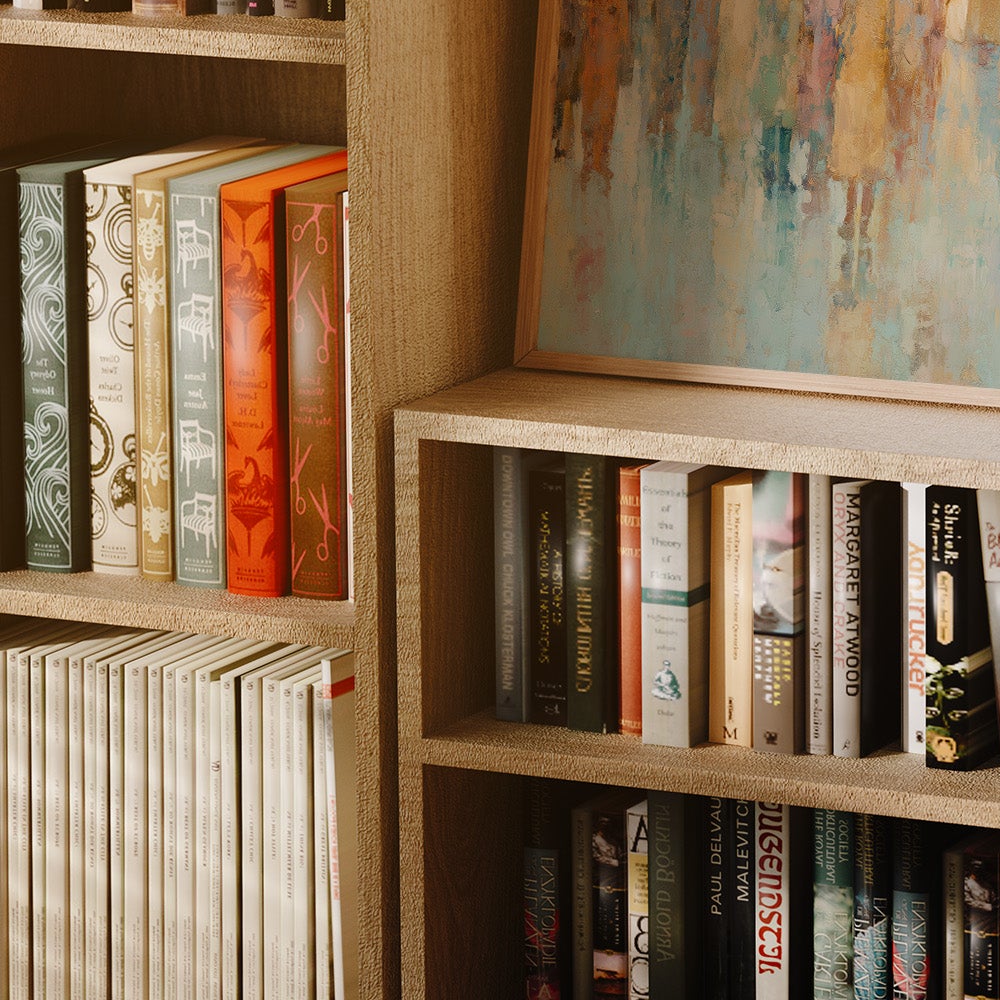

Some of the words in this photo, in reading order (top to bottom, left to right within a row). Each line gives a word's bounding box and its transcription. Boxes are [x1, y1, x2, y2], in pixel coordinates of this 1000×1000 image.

[502, 455, 514, 528] DOWNTOWN
[833, 492, 846, 543] ORYX
[502, 530, 513, 557] OWL
[833, 553, 846, 593] AND
[845, 493, 859, 605] MARGARET
[833, 600, 846, 669] CRAKE
[845, 613, 859, 698] ATWOOD
[710, 872, 722, 916] PAUL
